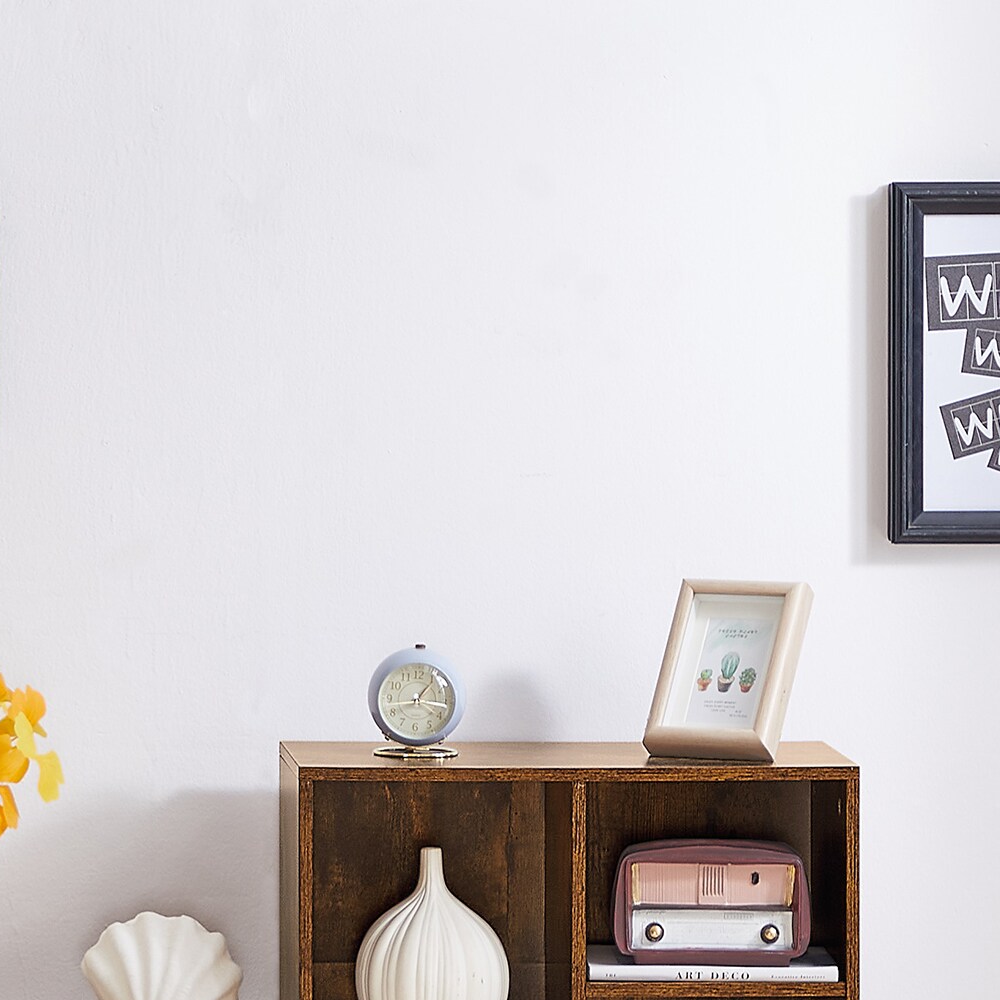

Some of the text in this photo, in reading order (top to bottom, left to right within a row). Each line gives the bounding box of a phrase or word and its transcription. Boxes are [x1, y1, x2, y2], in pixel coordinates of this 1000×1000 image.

[402, 672, 411, 681] 11
[414, 670, 424, 680] 12
[391, 681, 401, 691] 10
[386, 694, 393, 703] 9
[390, 707, 396, 717] 8
[400, 717, 405, 727] 7
[427, 720, 432, 729] 5
[412, 723, 418, 732] 6
[674, 971, 704, 981] ART
[711, 971, 750, 981] DECO
